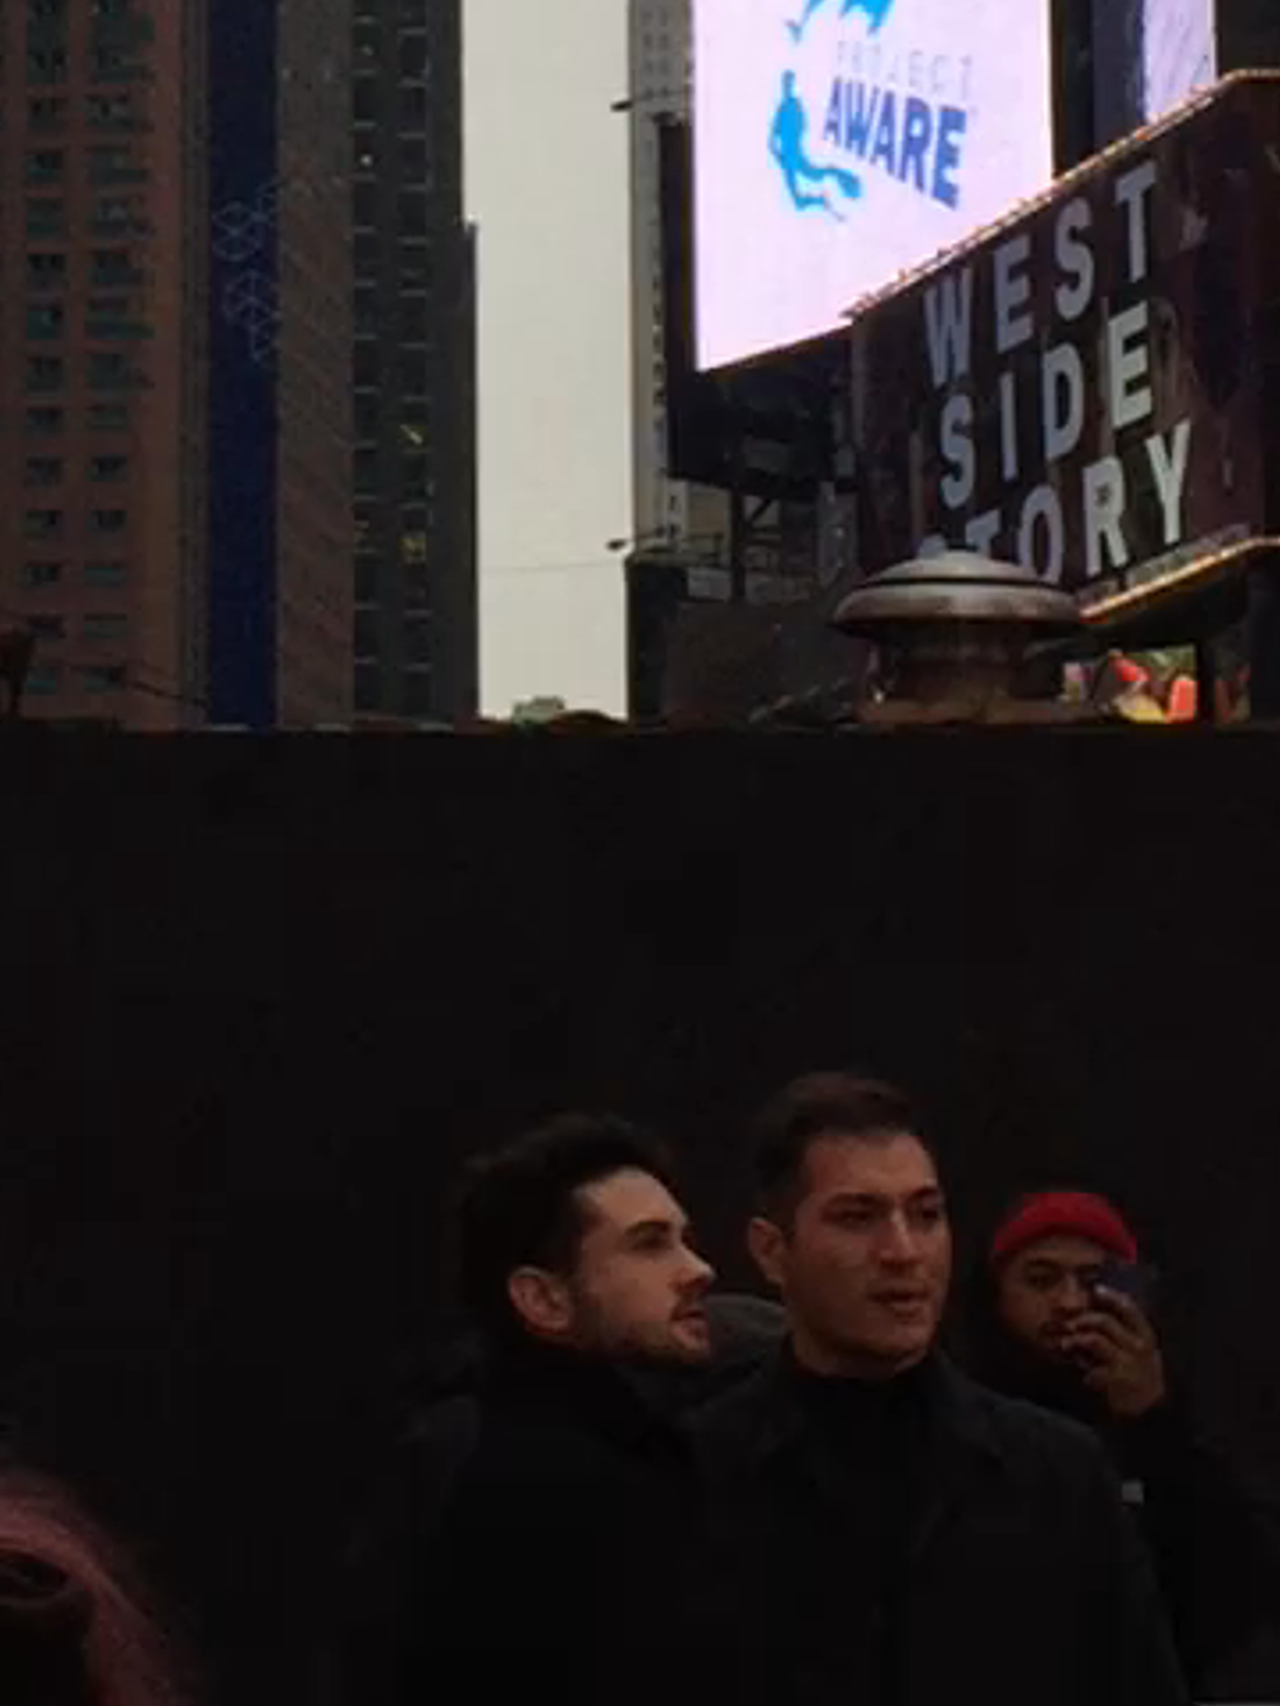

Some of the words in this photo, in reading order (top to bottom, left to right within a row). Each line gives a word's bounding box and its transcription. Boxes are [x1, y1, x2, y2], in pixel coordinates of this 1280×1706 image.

[822, 74, 968, 212] AWARE
[924, 160, 1156, 386] WEST
[938, 300, 1150, 508] SIDE
[912, 417, 1192, 584] TORY
